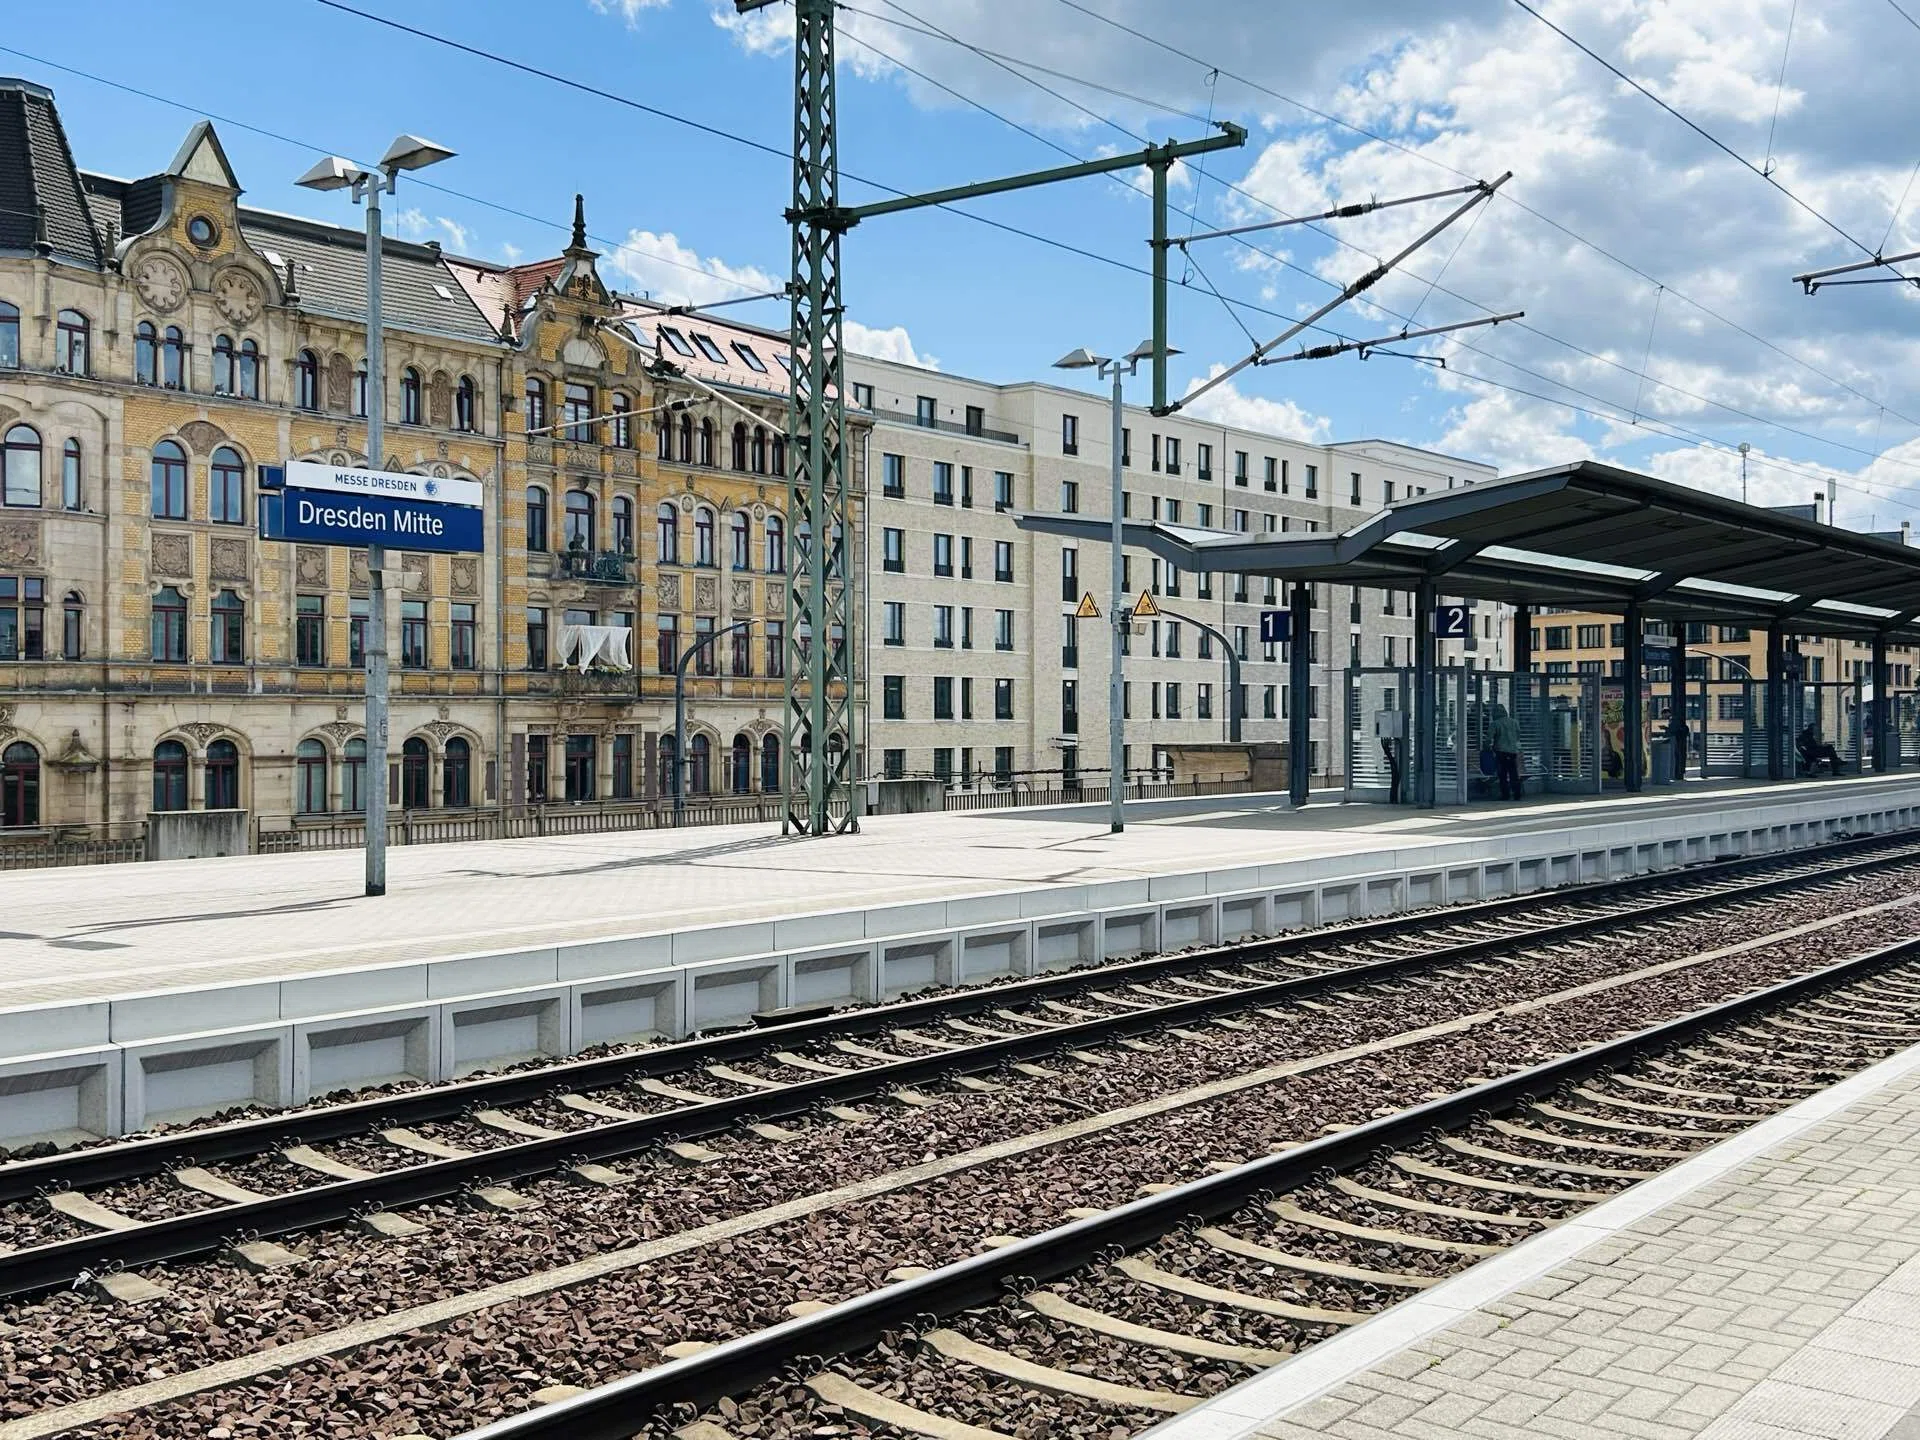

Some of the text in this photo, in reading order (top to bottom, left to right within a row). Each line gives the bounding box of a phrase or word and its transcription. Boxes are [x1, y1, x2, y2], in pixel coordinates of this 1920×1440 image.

[335, 473, 417, 492] MESSE DRESDEN
[299, 500, 444, 536] Dresden Mitte
[1264, 613, 1273, 637] 1
[1448, 607, 1464, 633] 2
